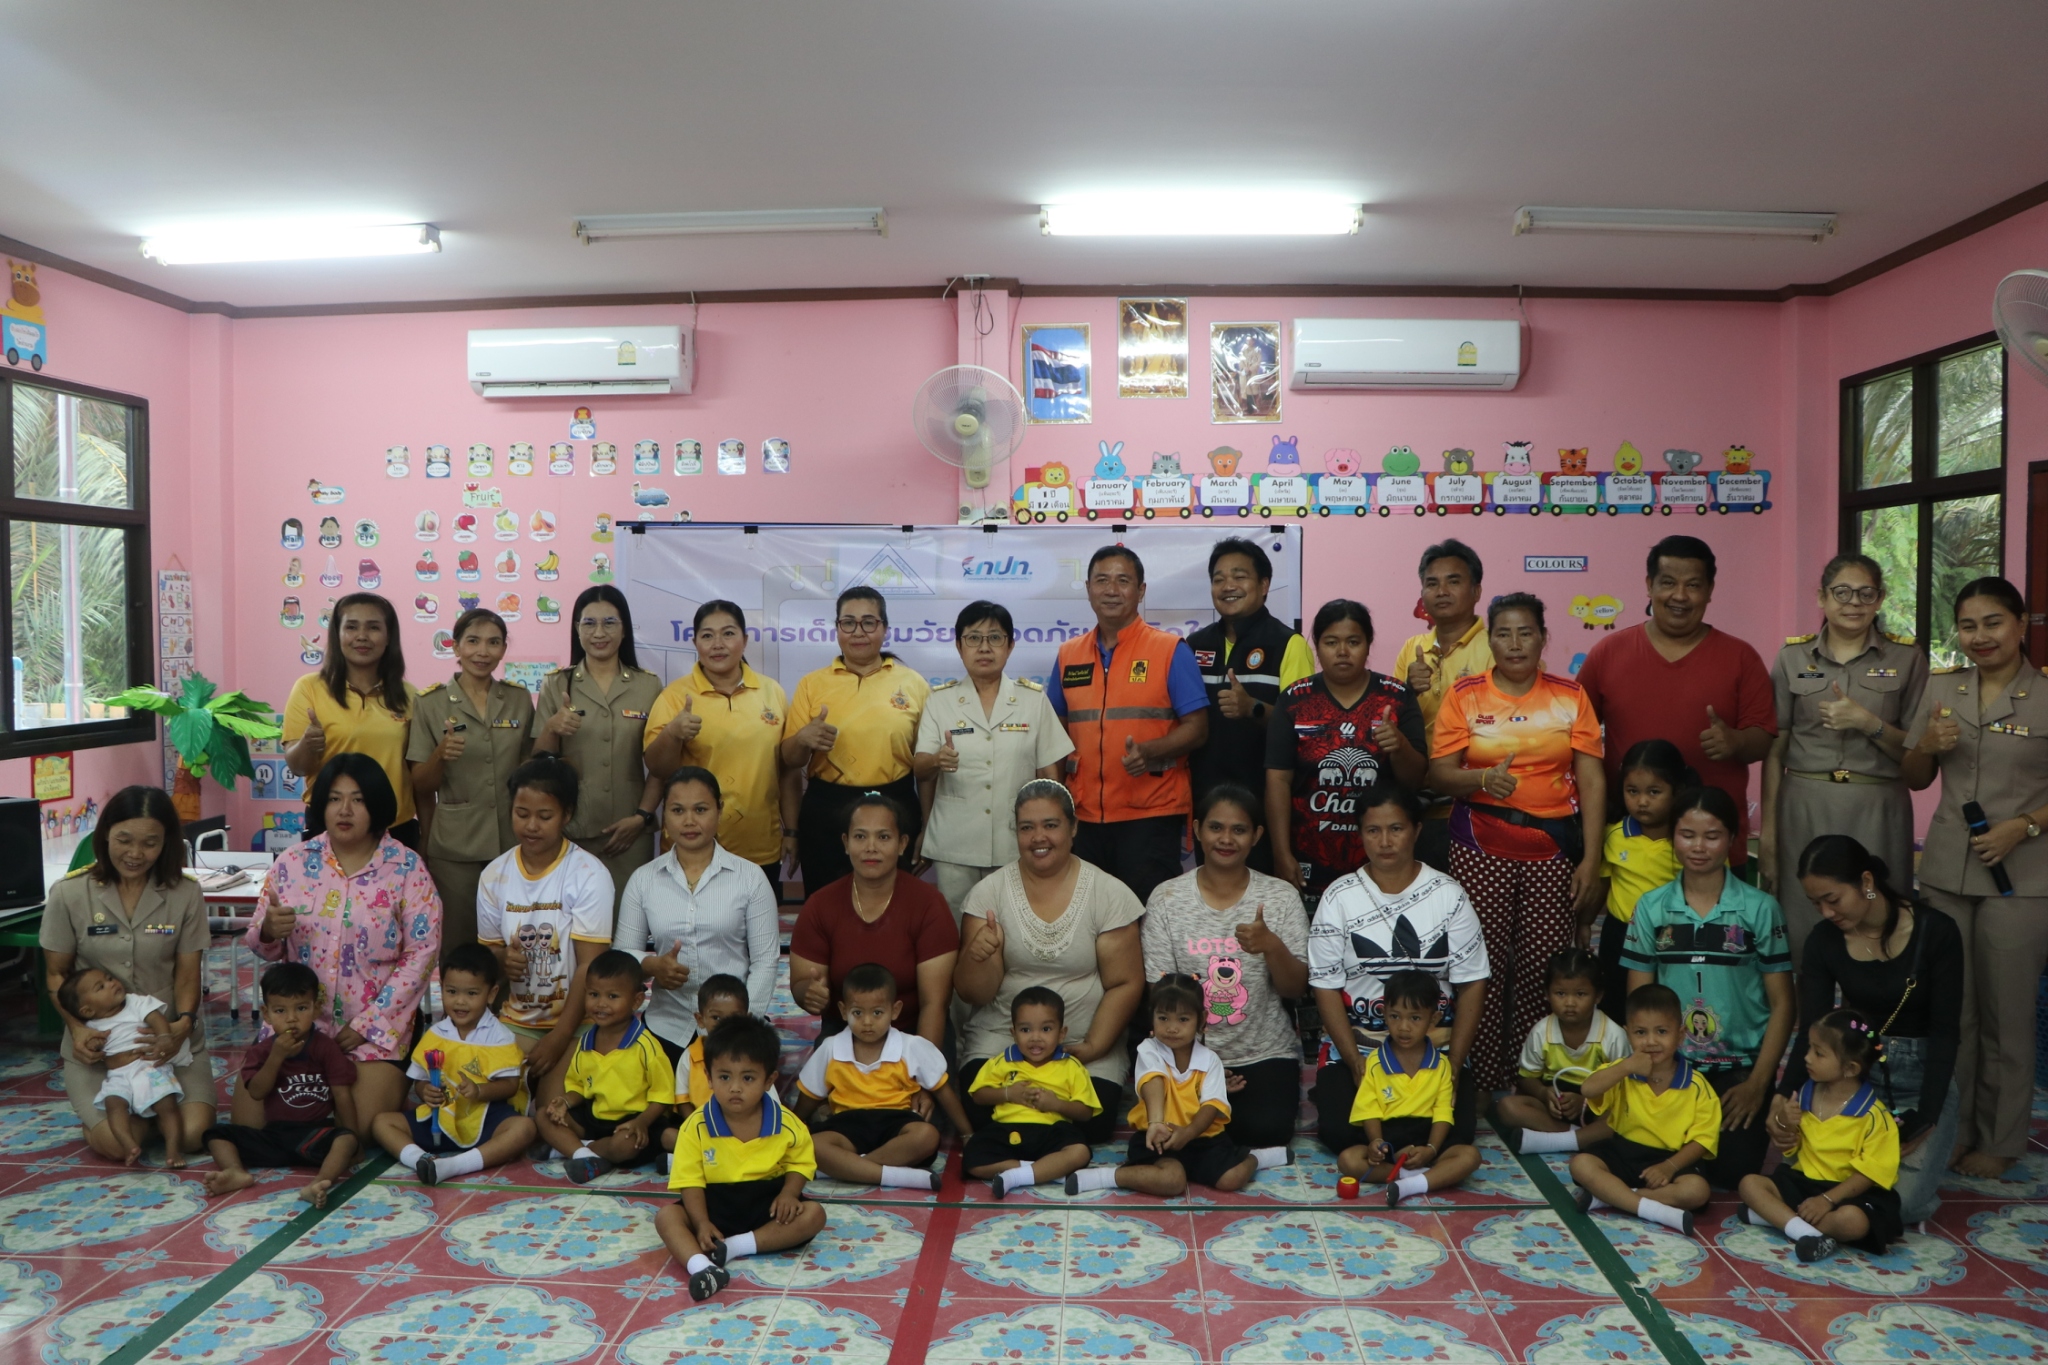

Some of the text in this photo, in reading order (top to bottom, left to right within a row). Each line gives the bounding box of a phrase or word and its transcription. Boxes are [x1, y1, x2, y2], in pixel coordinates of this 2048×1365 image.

[1092, 482, 1128, 490] January
[1146, 480, 1186, 488] February
[1272, 479, 1293, 488] April
[1333, 478, 1353, 487] May
[1448, 478, 1466, 486] July
[1502, 479, 1532, 487] August
[1550, 479, 1597, 487] September
[470, 492, 495, 502] Fruit
[1050, 490, 1056, 498] ปี
[1503, 494, 1532, 502] สิงหาคม
[1559, 494, 1588, 502] กันยายน
[1618, 494, 1642, 502] ตุลาคม
[1726, 493, 1755, 502] ธันวาคม
[1148, 495, 1185, 505] กุมภาพันธ์
[1210, 496, 1237, 504] มีนาคม
[1325, 495, 1362, 504] พฤษภาคม
[1386, 495, 1417, 503] มิถุนายน
[1441, 495, 1475, 503] กรกฎาคม
[1664, 495, 1703, 503] พฤศจิกายน
[360, 533, 374, 543] Eye
[1528, 559, 1583, 569] COLOURS
[287, 574, 300, 582] Ear
[1595, 606, 1614, 615] yellow
[162, 616, 170, 628] C
[178, 616, 184, 627] D
[162, 660, 170, 672] G
[178, 660, 184, 671] H
[259, 769, 268, 779] ท
[1310, 790, 1356, 814] Cha
[1187, 937, 1244, 955] LOTS
[1696, 972, 1702, 994] 1
